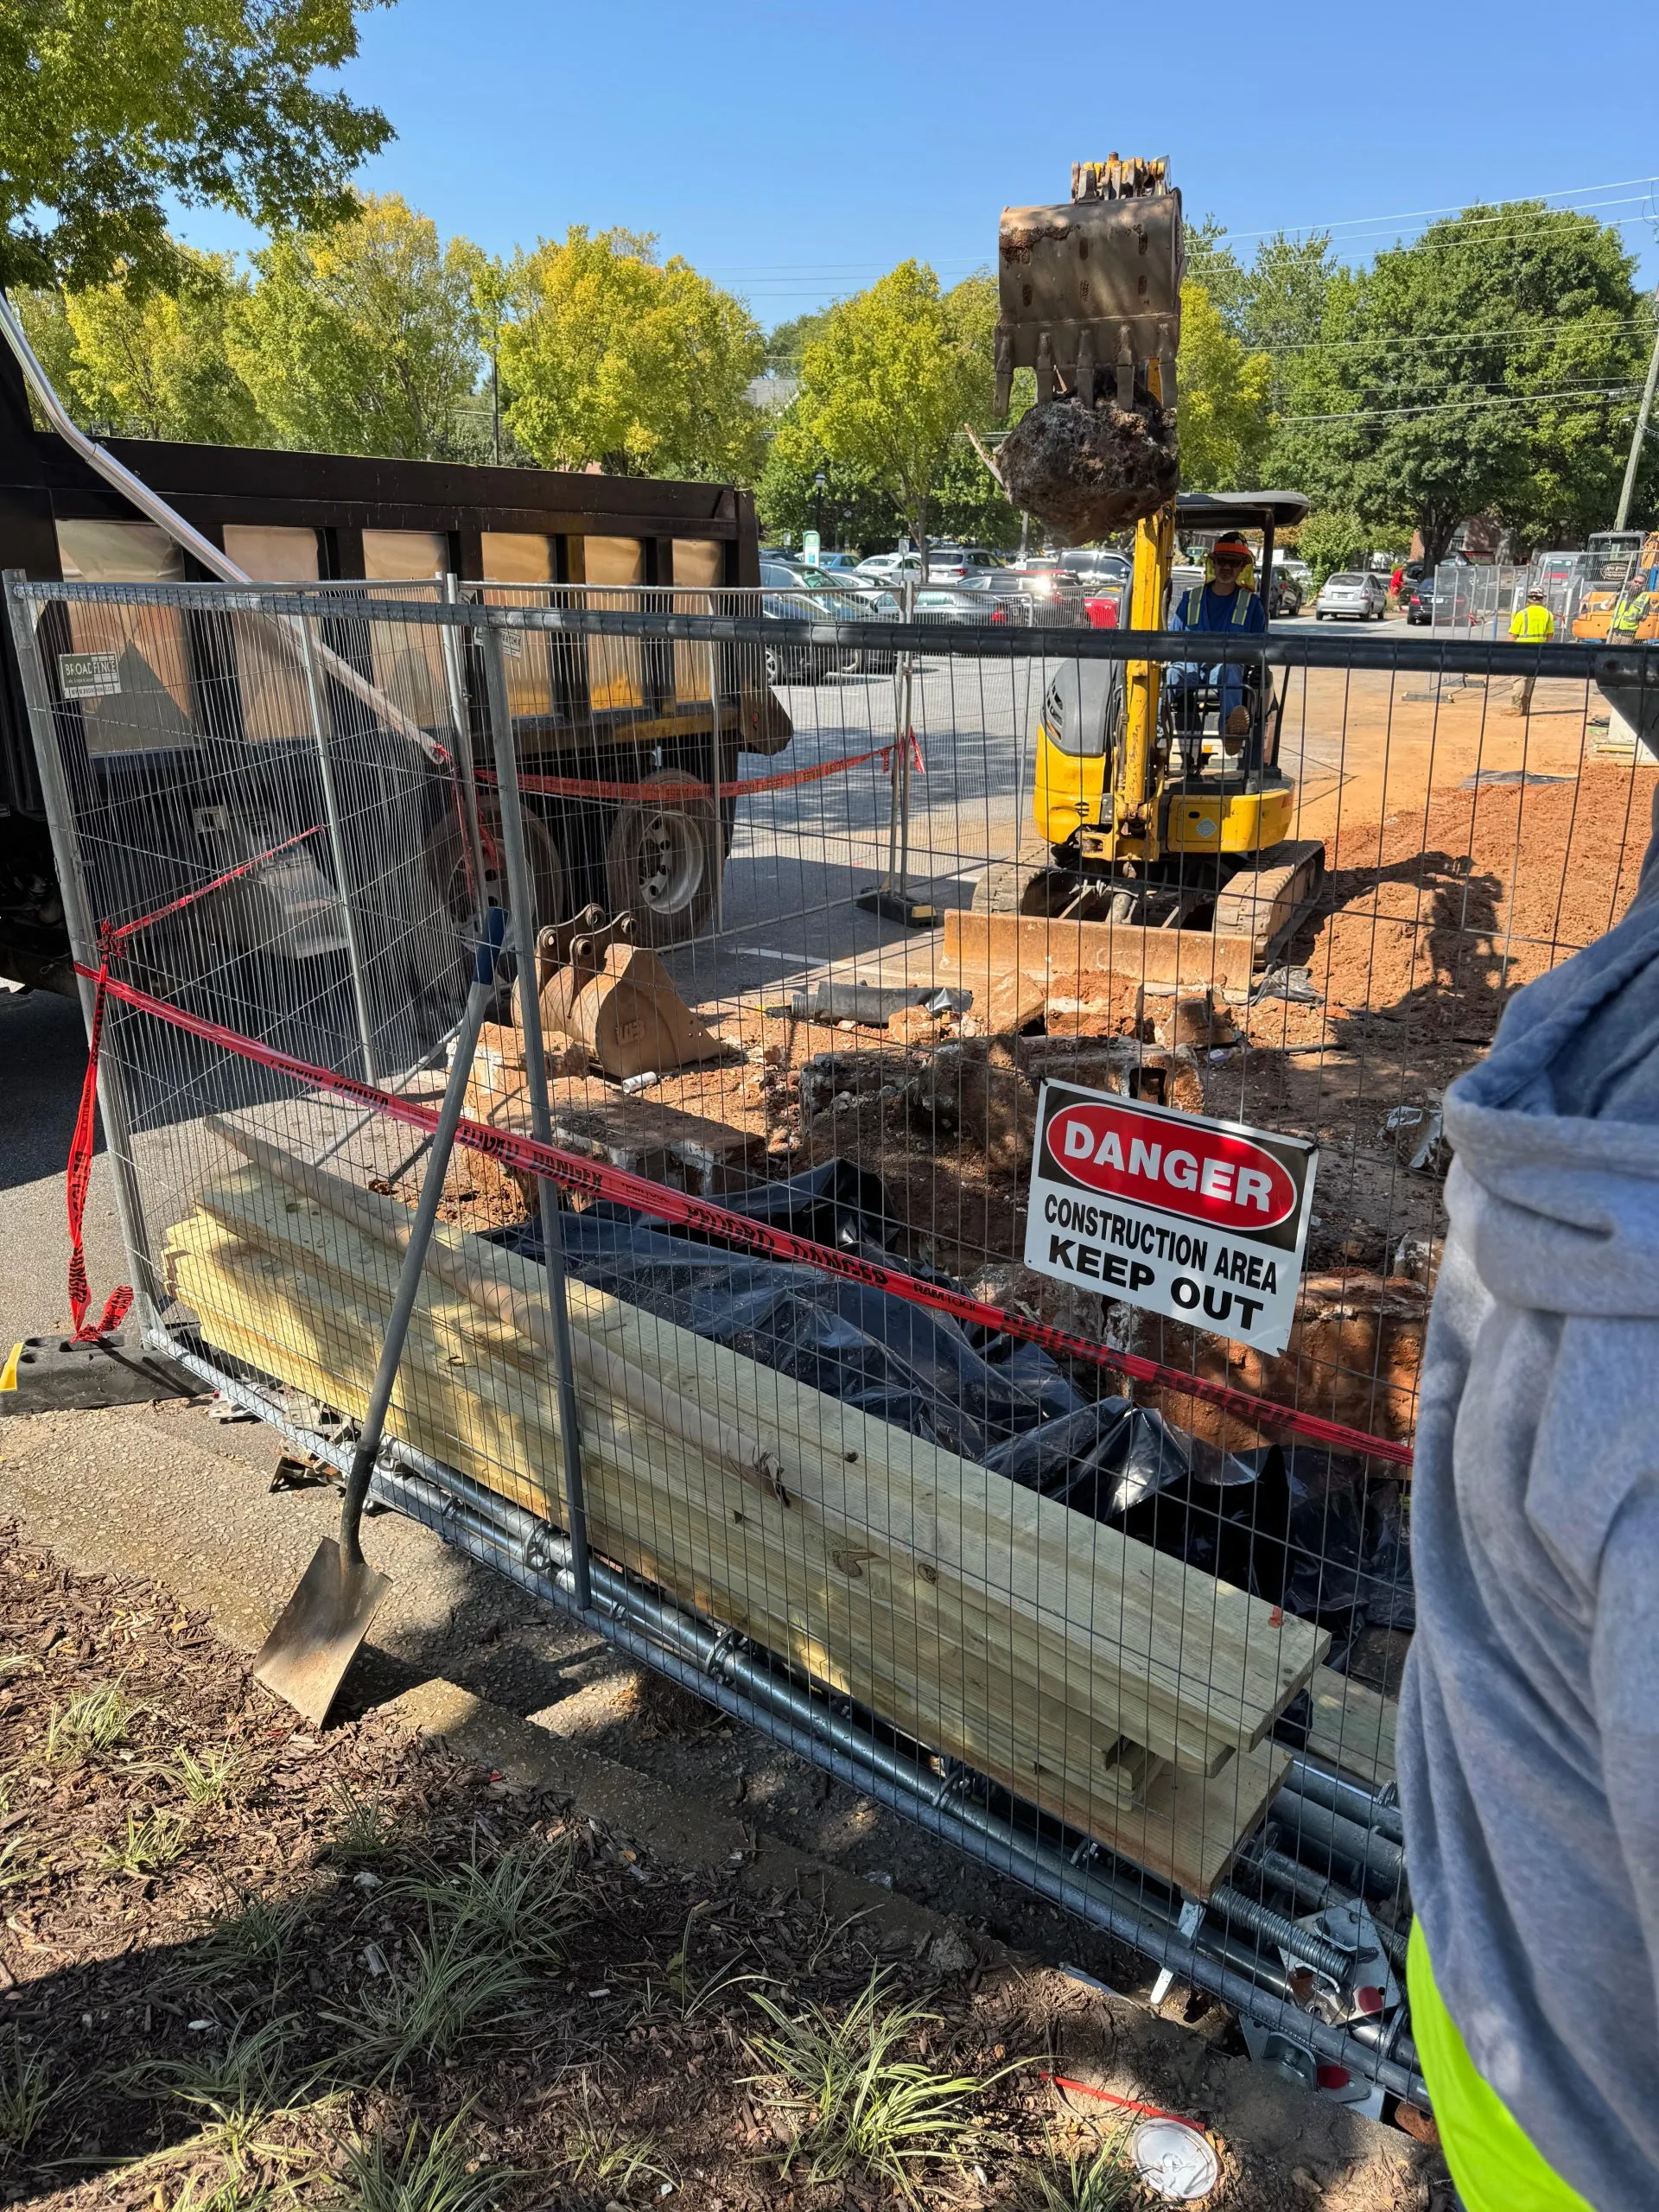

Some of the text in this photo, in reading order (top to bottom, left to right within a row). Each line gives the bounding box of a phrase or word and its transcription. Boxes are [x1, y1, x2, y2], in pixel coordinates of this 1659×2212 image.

[457, 1125, 519, 1160] ELIGRO
[1064, 1120, 1273, 1212] DANGER
[1045, 1193, 1277, 1294] CONSTRUCTION AREA
[1048, 1234, 1263, 1331] KEEP OUT
